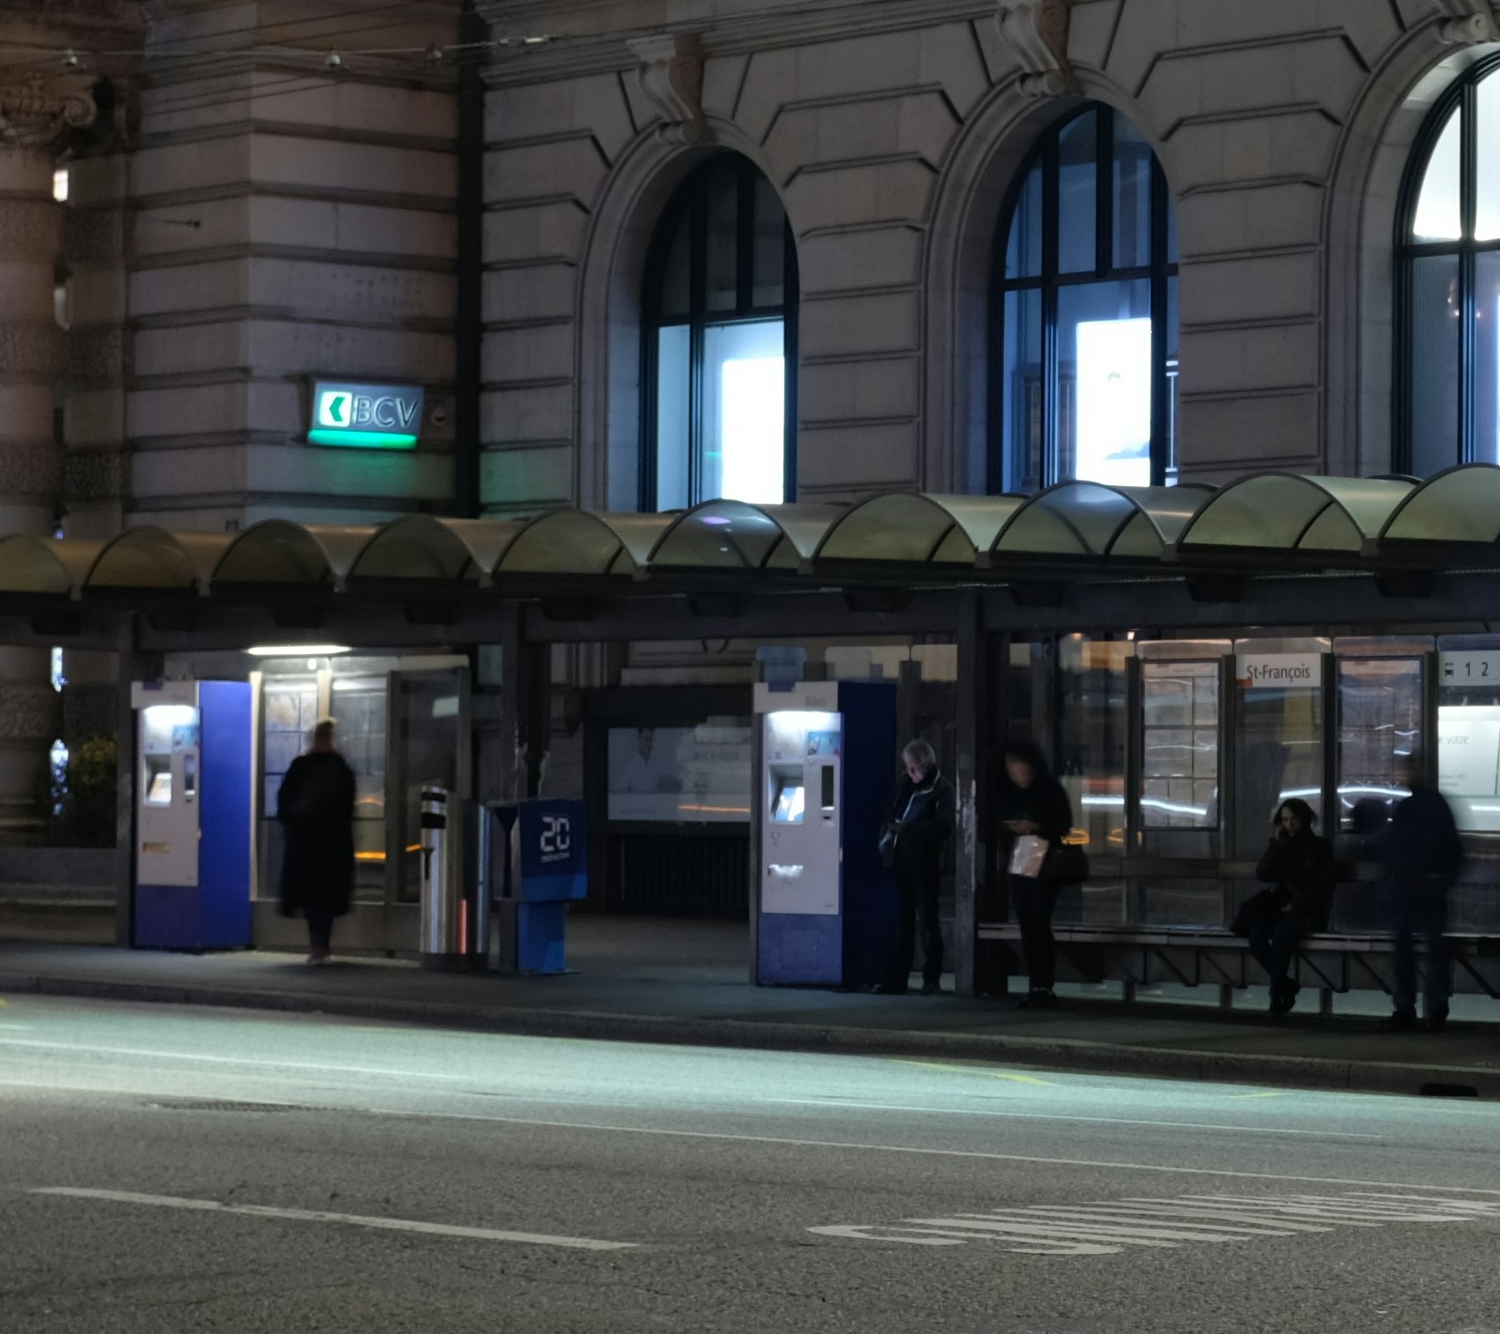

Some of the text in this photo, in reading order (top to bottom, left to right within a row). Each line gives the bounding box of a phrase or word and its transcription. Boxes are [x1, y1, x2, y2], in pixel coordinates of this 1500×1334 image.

[354, 395, 419, 427] BCV
[1246, 663, 1311, 683] St-François
[1466, 662, 1471, 677] 1
[1482, 662, 1489, 677] 2
[540, 816, 570, 853] 20
